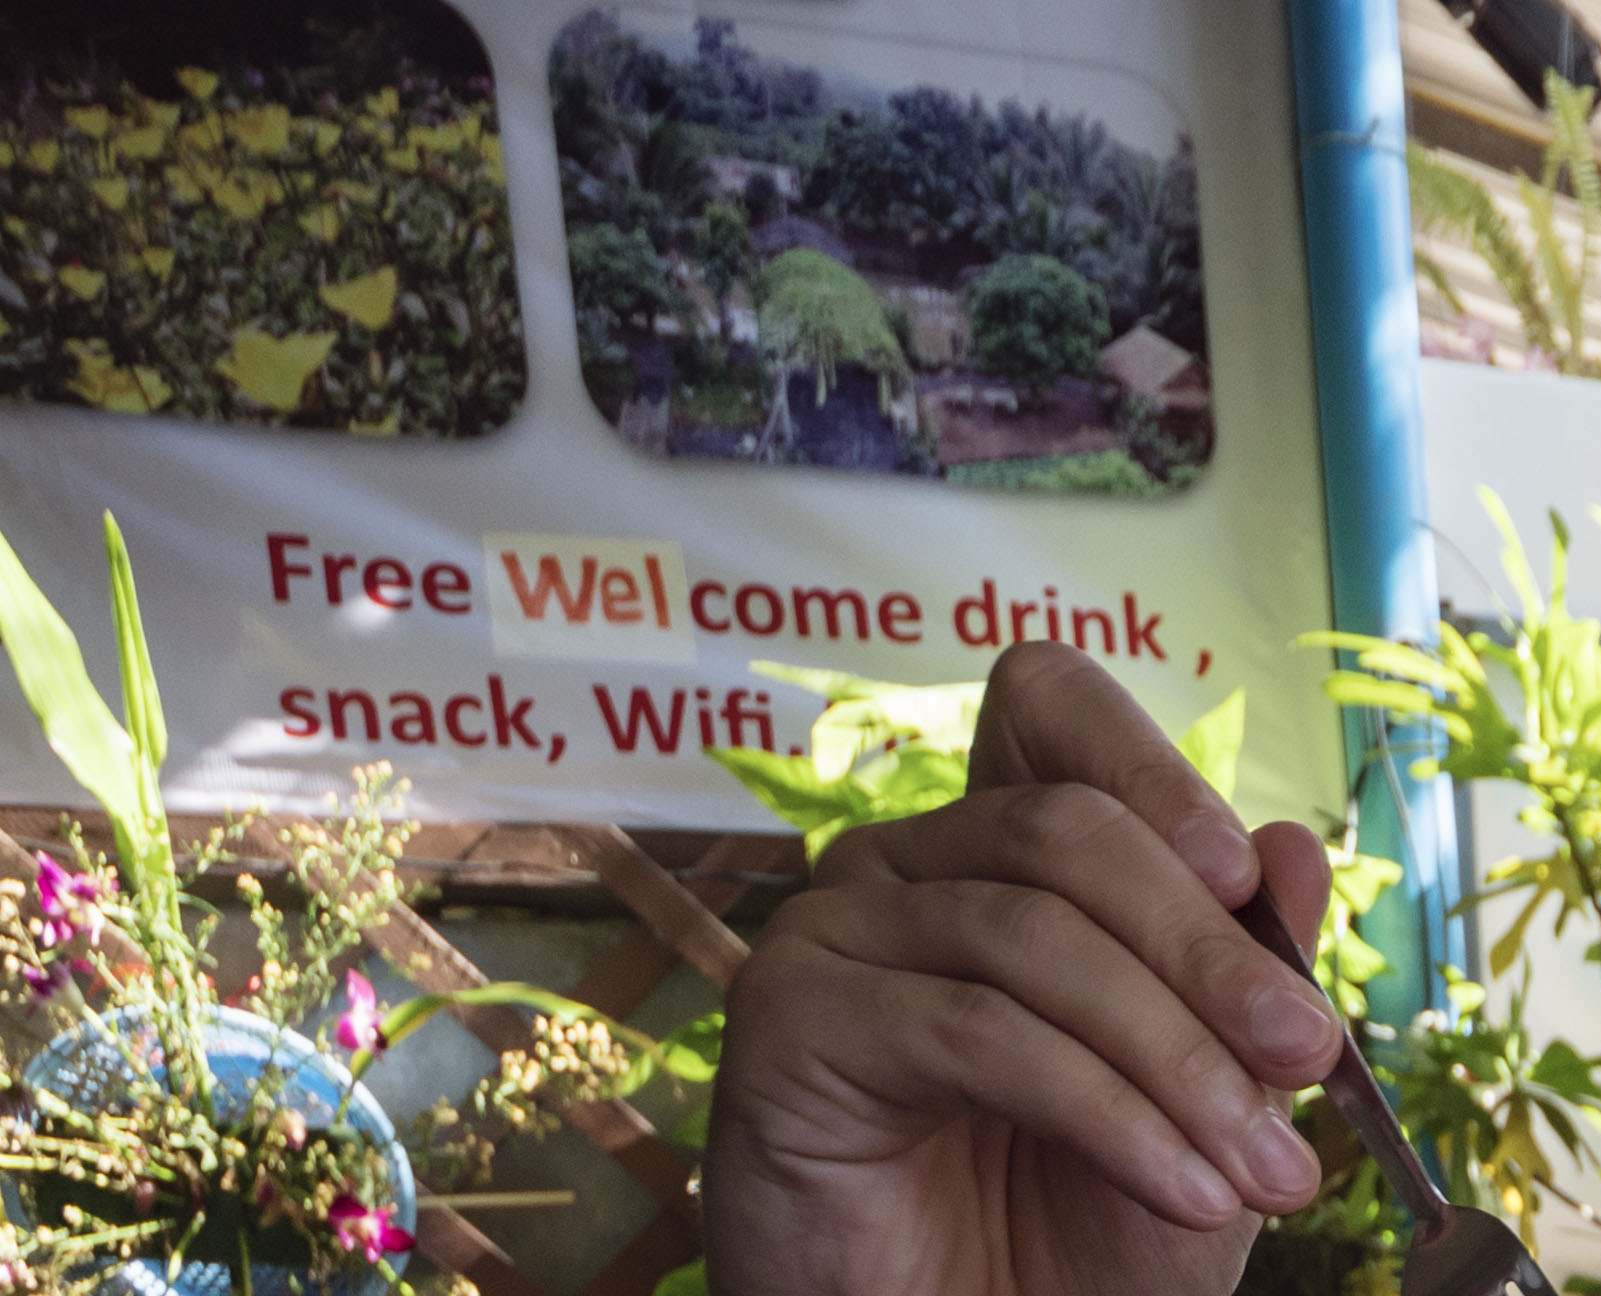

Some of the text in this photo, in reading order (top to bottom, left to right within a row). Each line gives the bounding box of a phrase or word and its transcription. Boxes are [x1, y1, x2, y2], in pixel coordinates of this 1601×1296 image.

[265, 533, 473, 615] Free
[951, 578, 1167, 661] drink
[279, 675, 567, 764] snack,
